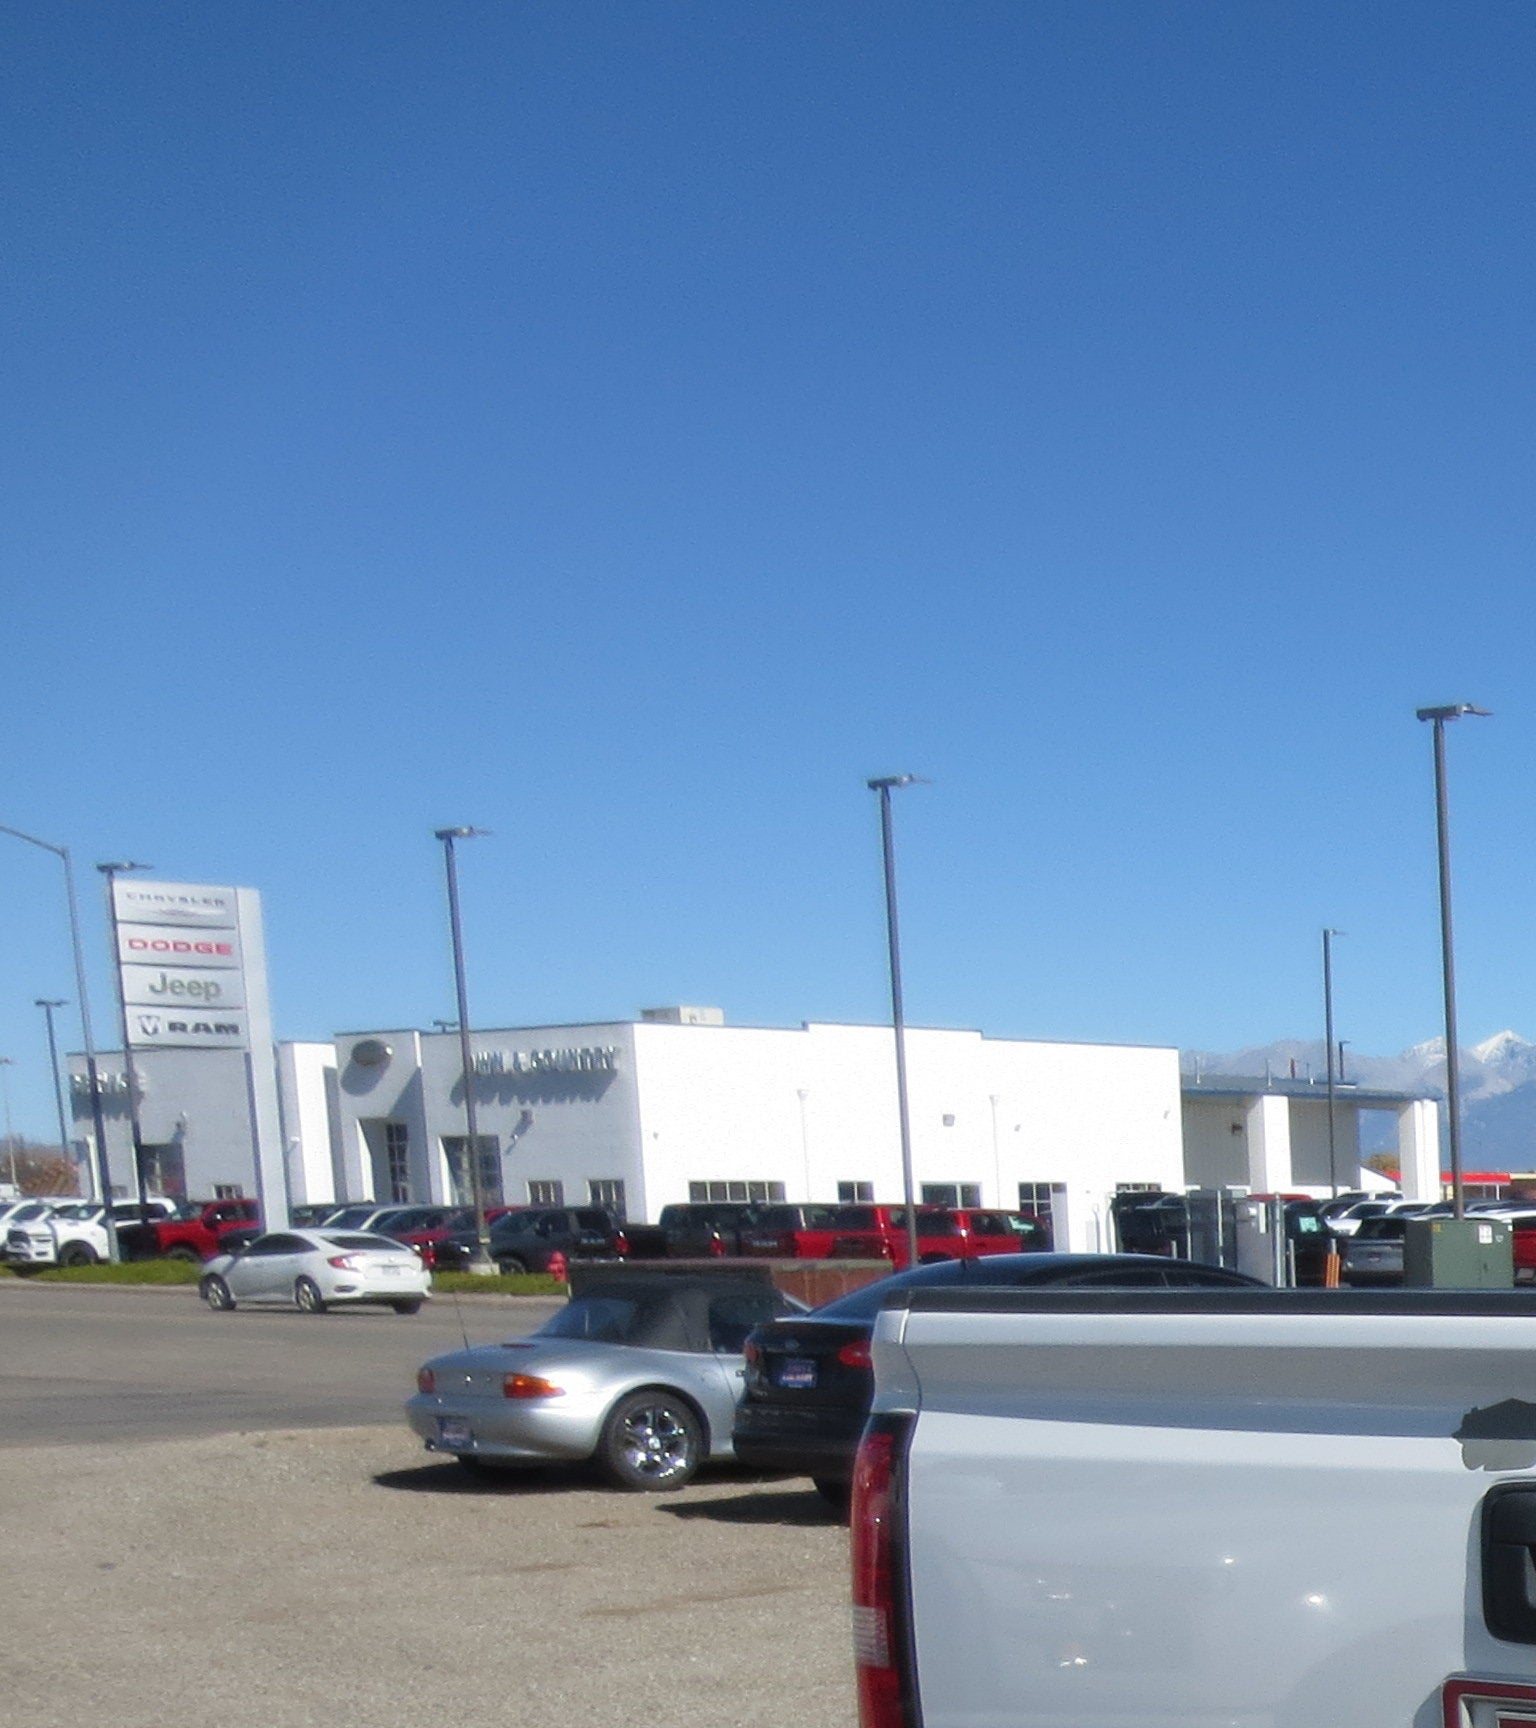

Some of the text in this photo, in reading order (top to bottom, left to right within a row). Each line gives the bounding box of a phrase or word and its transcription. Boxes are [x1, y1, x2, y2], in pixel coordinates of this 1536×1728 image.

[126, 891, 226, 907] CHRYSLER
[129, 938, 233, 956] DODGE
[149, 973, 222, 1001] Jeep
[168, 1022, 240, 1035] RAM
